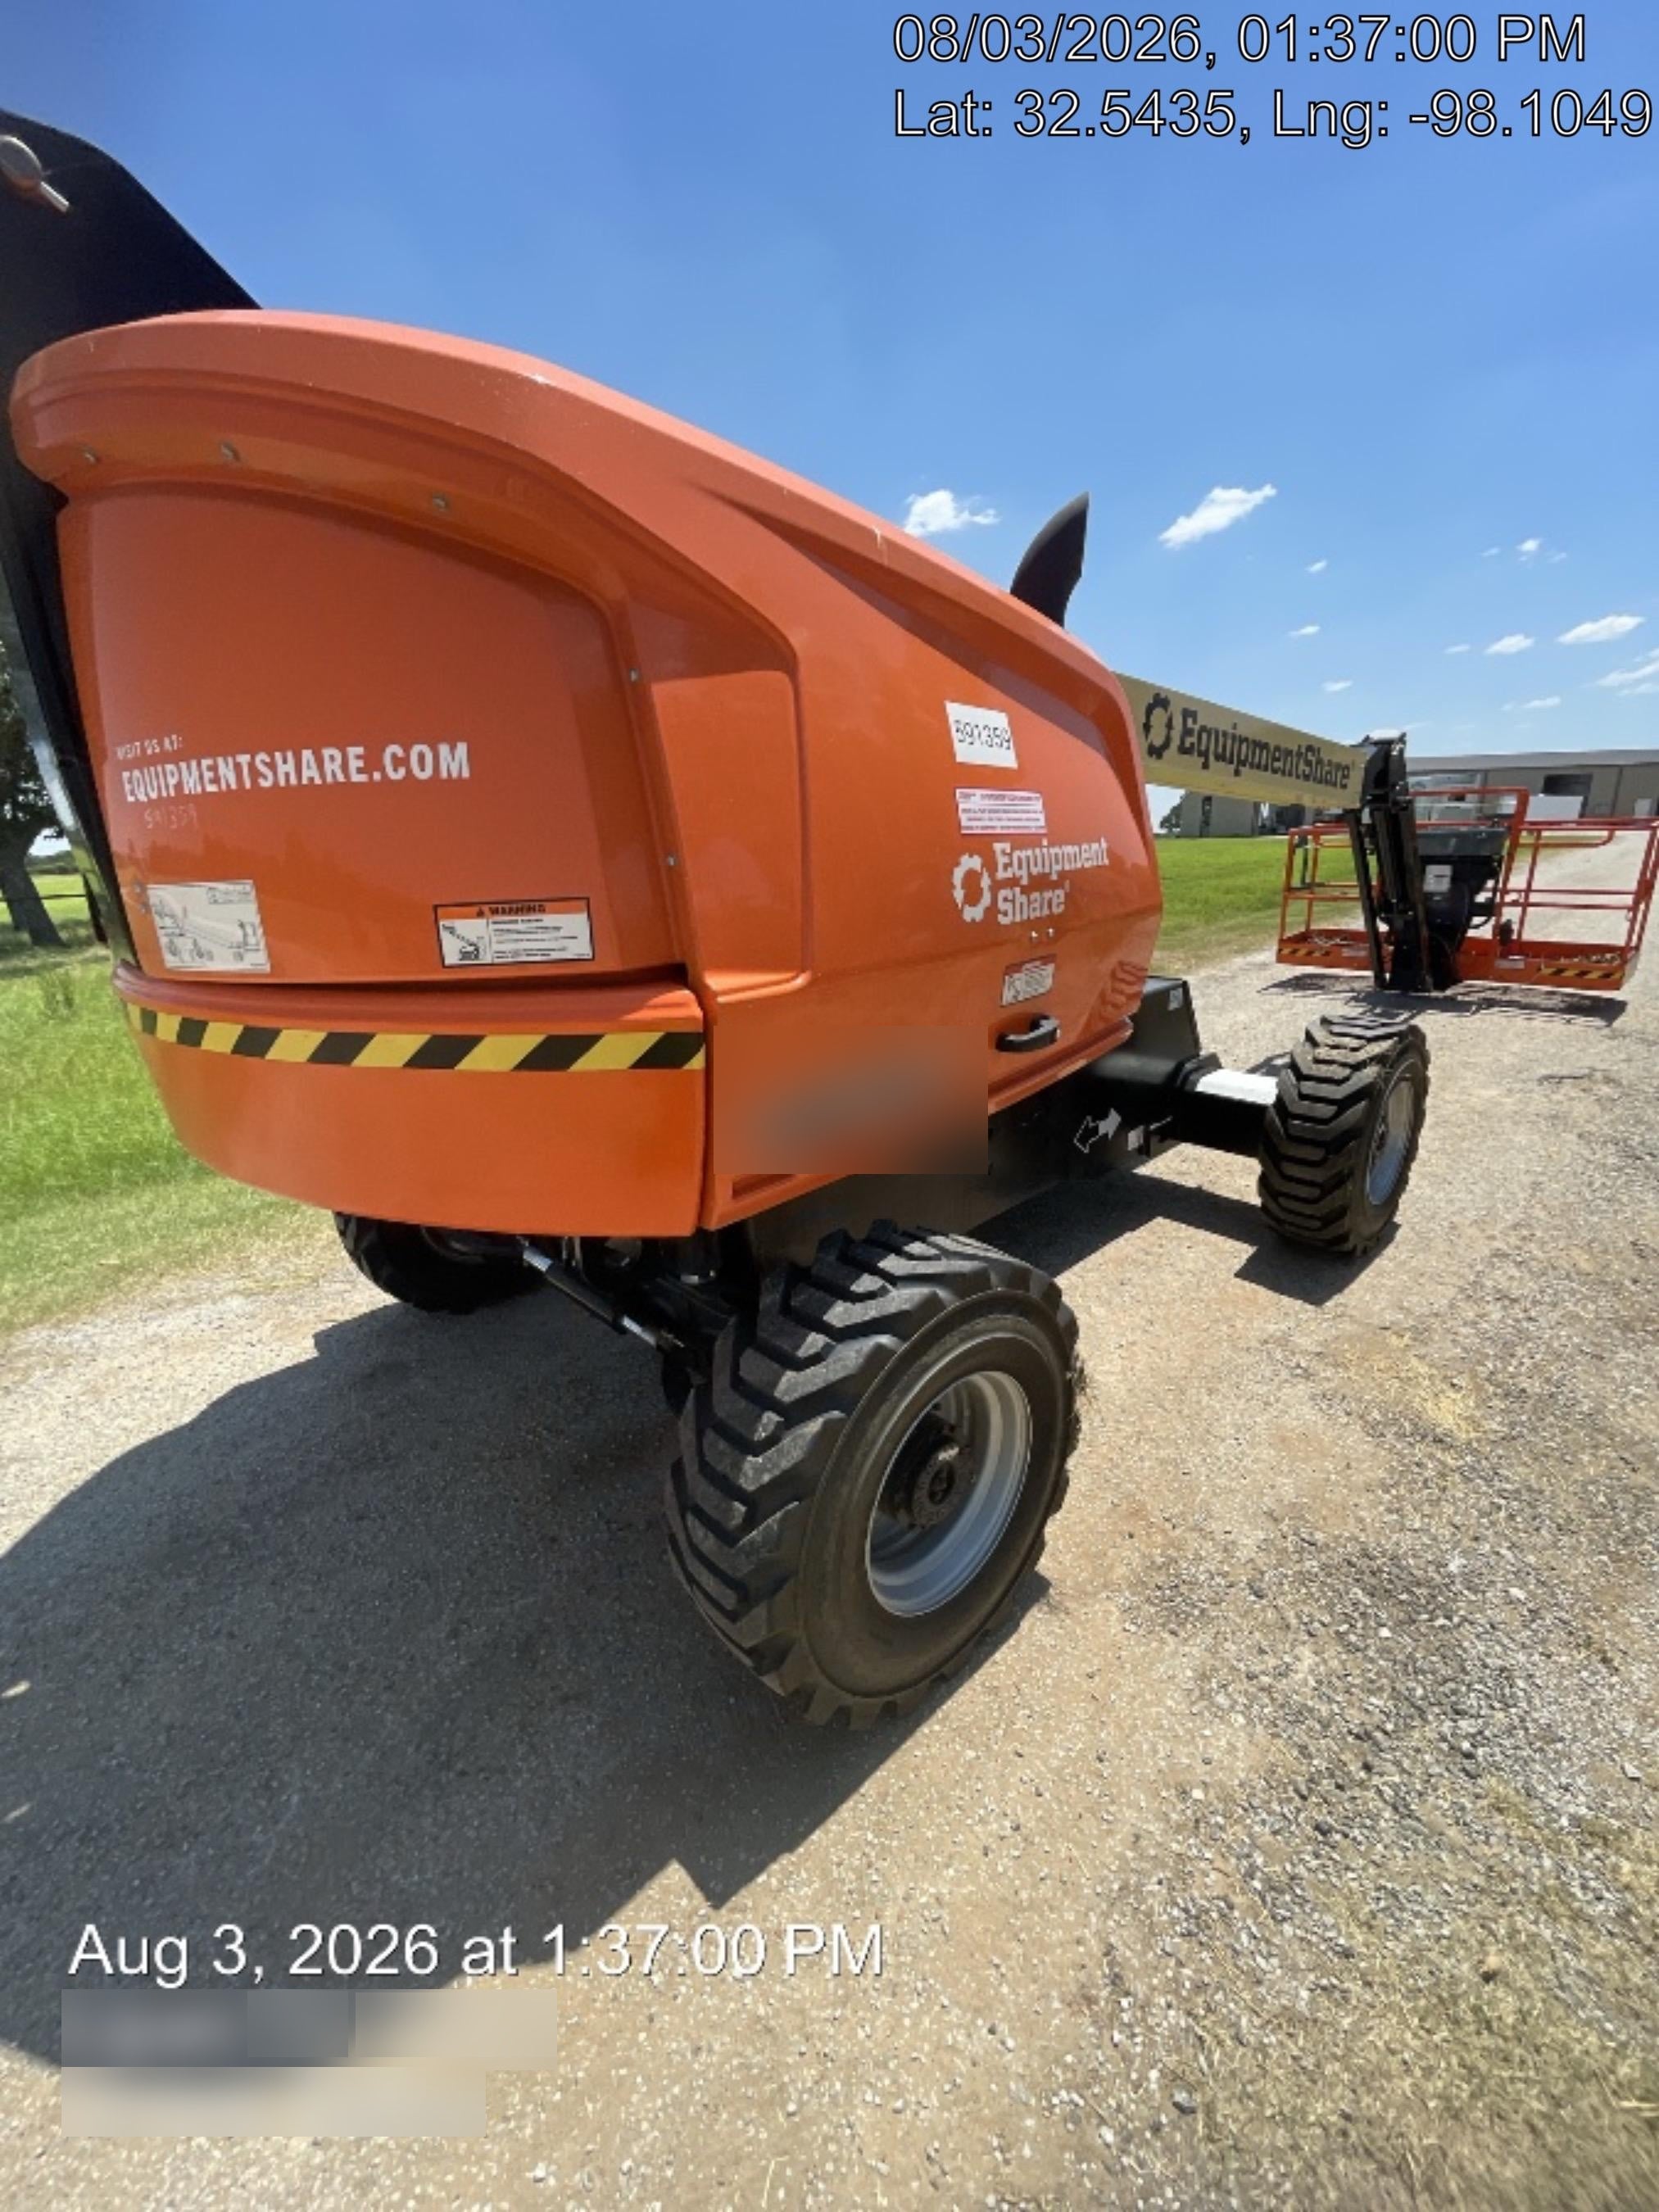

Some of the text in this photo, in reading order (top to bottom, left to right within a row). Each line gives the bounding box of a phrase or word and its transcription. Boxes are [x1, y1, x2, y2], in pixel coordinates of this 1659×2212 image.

[121, 741, 471, 803] EQUIPMENTSHARE.COM
[1177, 707, 1350, 790] EquipmentShare
[992, 836, 1110, 886] Equipment
[997, 886, 1065, 925] Share
